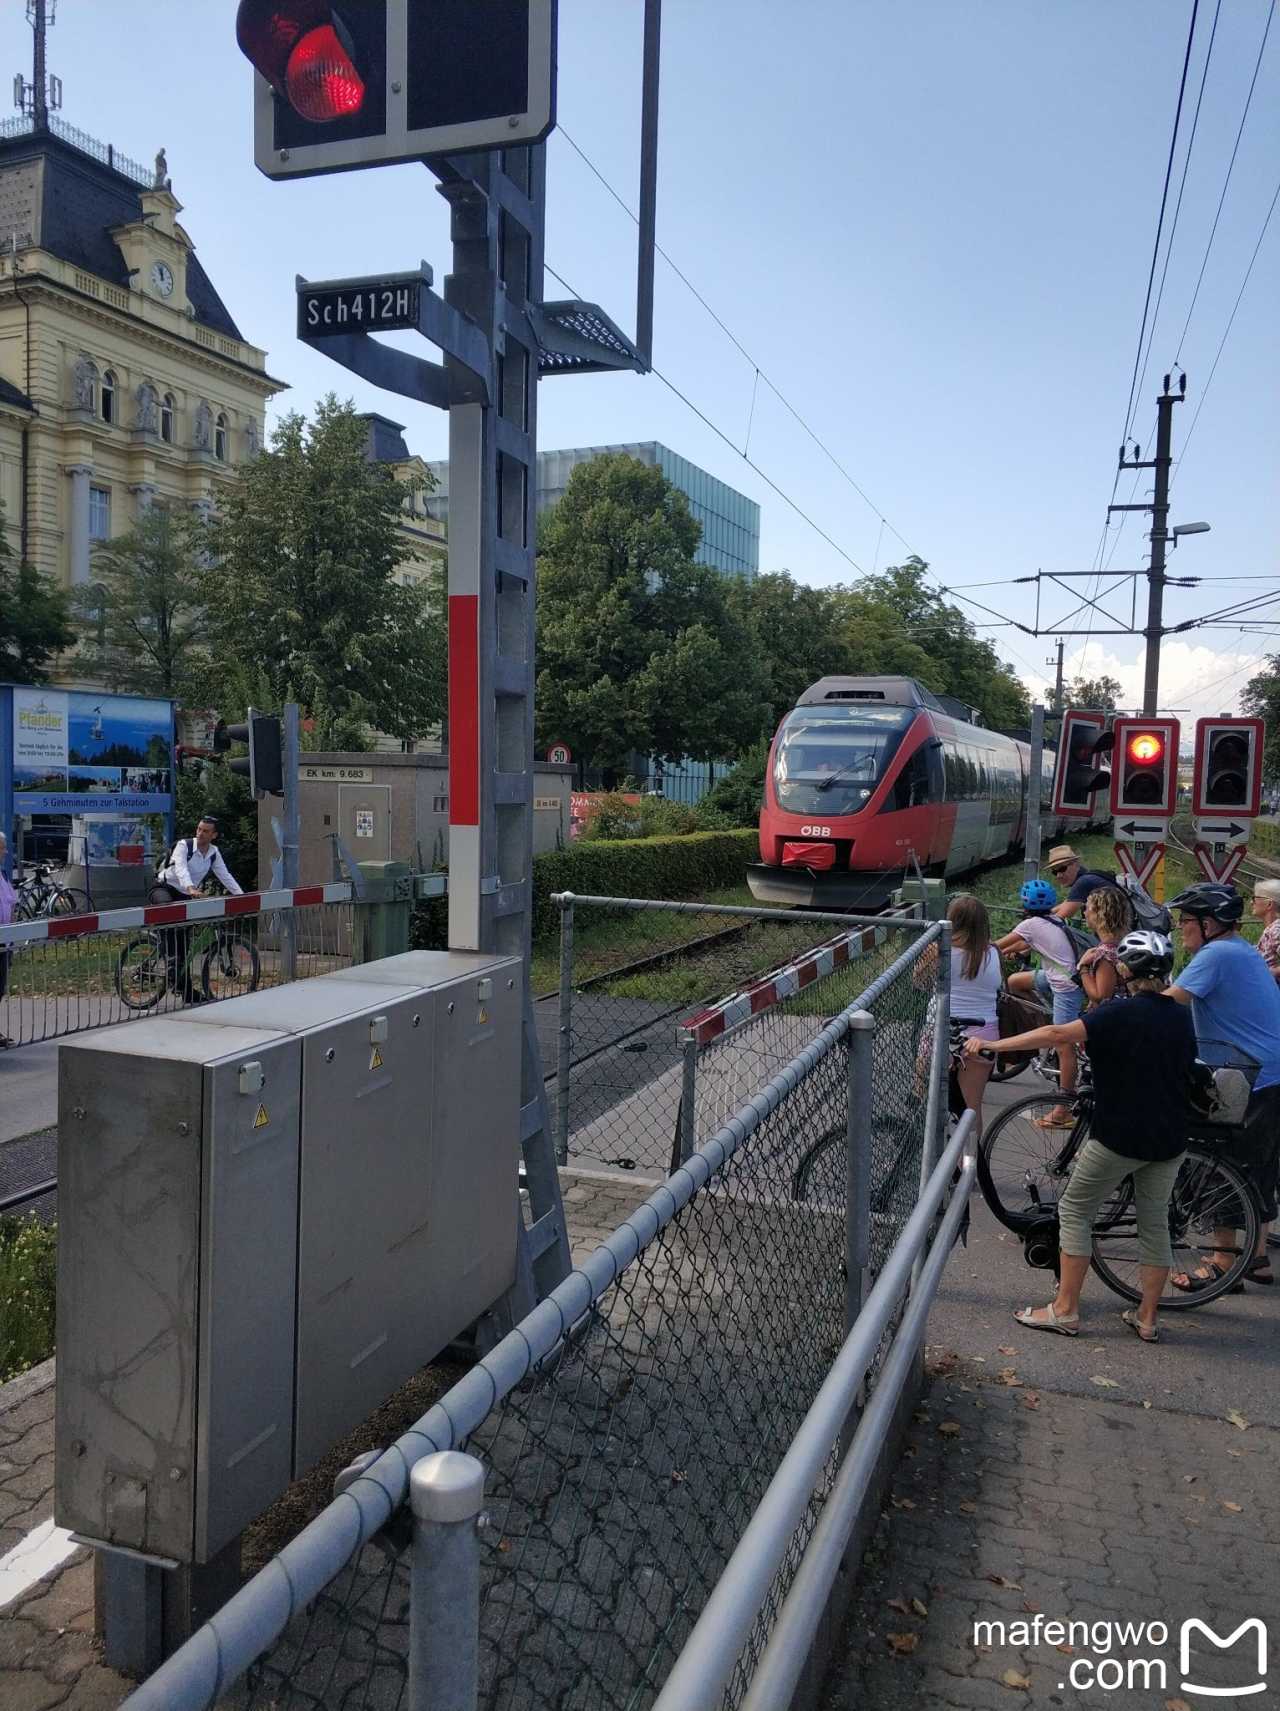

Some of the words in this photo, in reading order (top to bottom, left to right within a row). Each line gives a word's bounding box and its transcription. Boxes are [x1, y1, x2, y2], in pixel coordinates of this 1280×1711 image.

[307, 289, 409, 325] Sch412H
[555, 750, 565, 762] 50
[306, 769, 318, 777] EK
